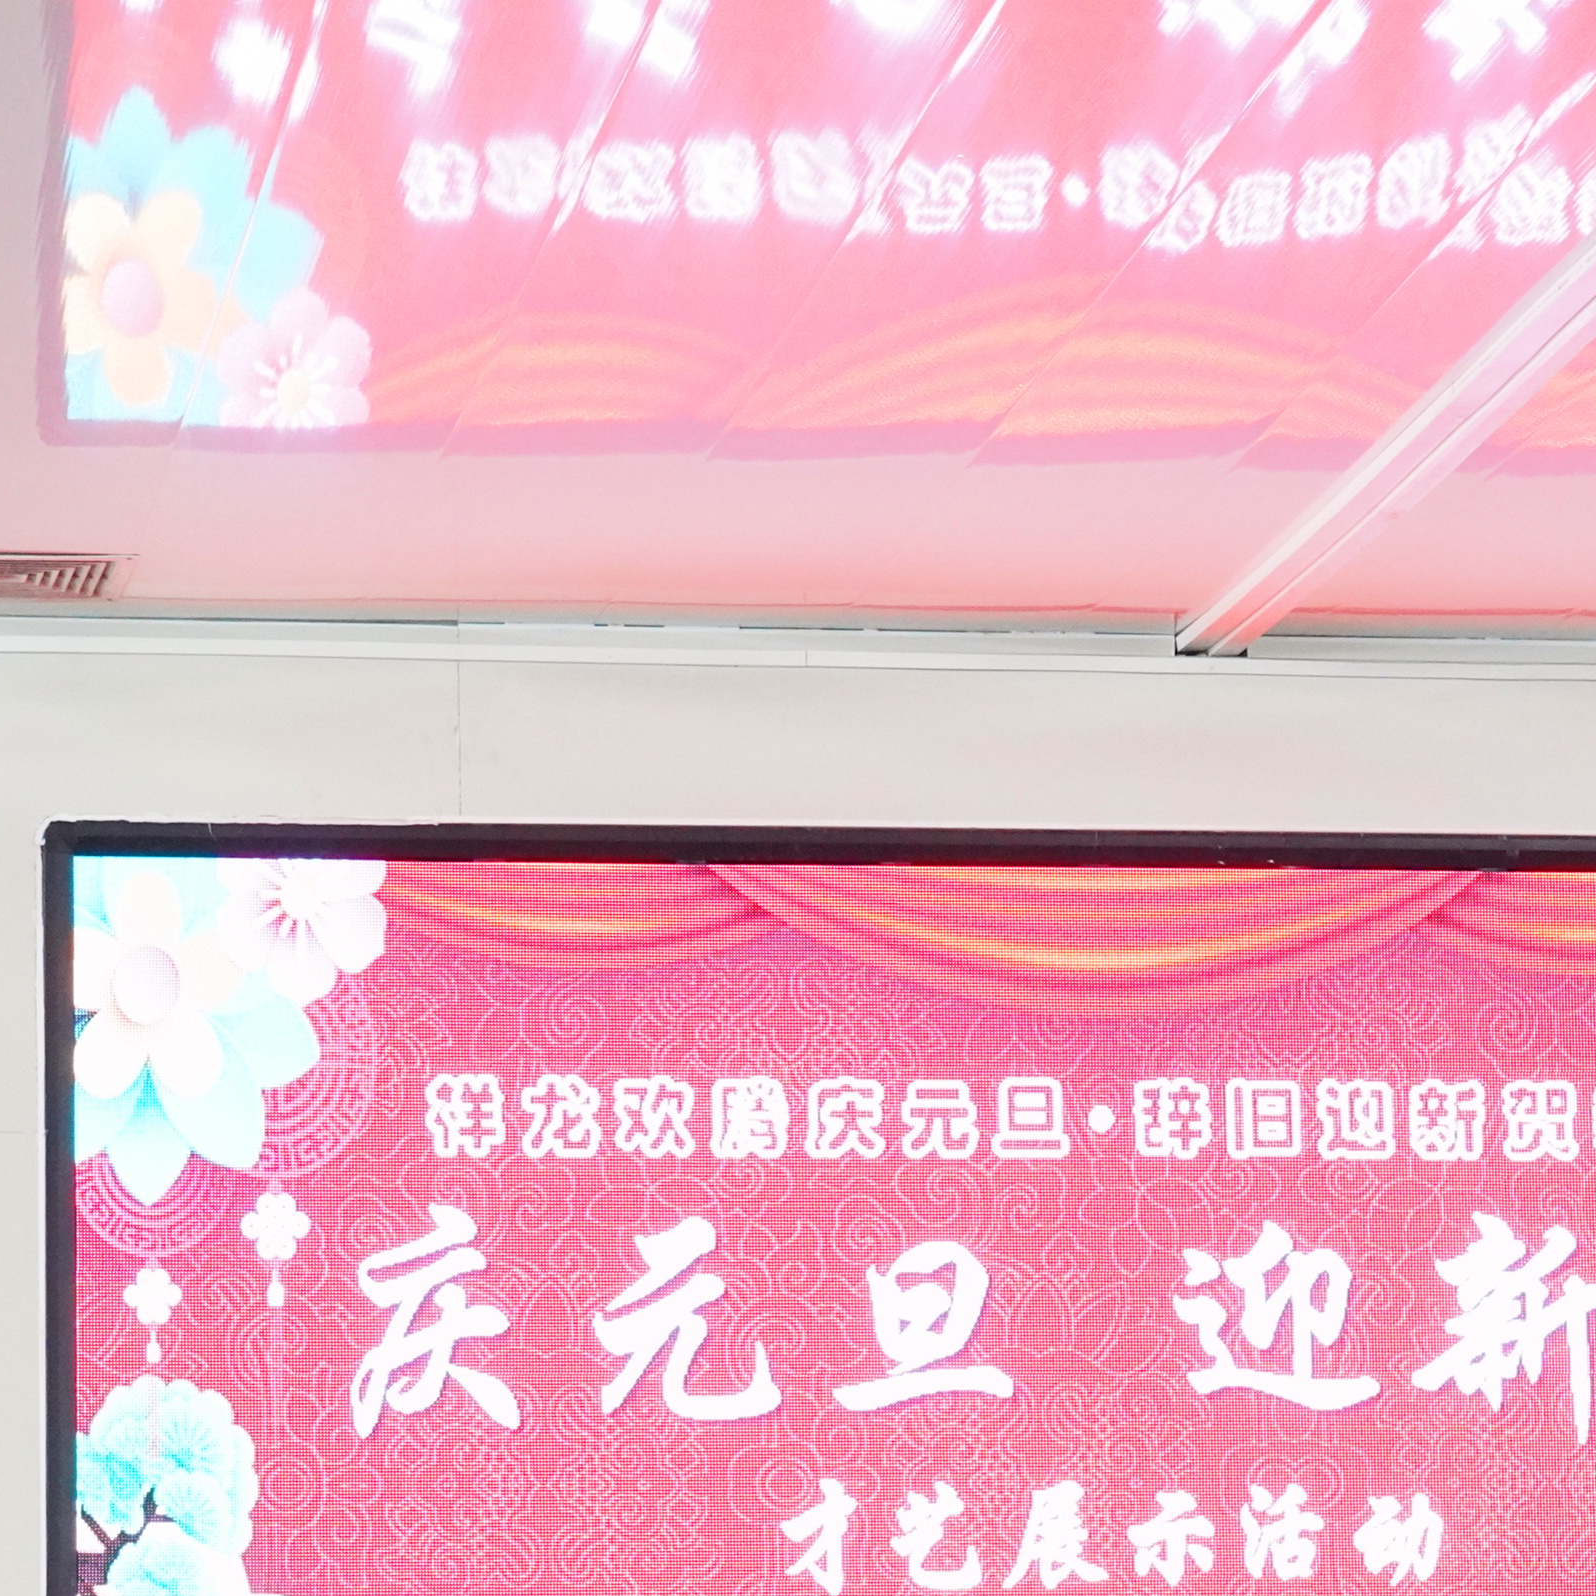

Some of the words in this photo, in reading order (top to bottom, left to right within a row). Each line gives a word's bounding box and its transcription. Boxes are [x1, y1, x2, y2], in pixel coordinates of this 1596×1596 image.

[351, 1203, 1014, 1439] 庆元旦
[780, 1478, 1445, 1596] 才艺展示活动
